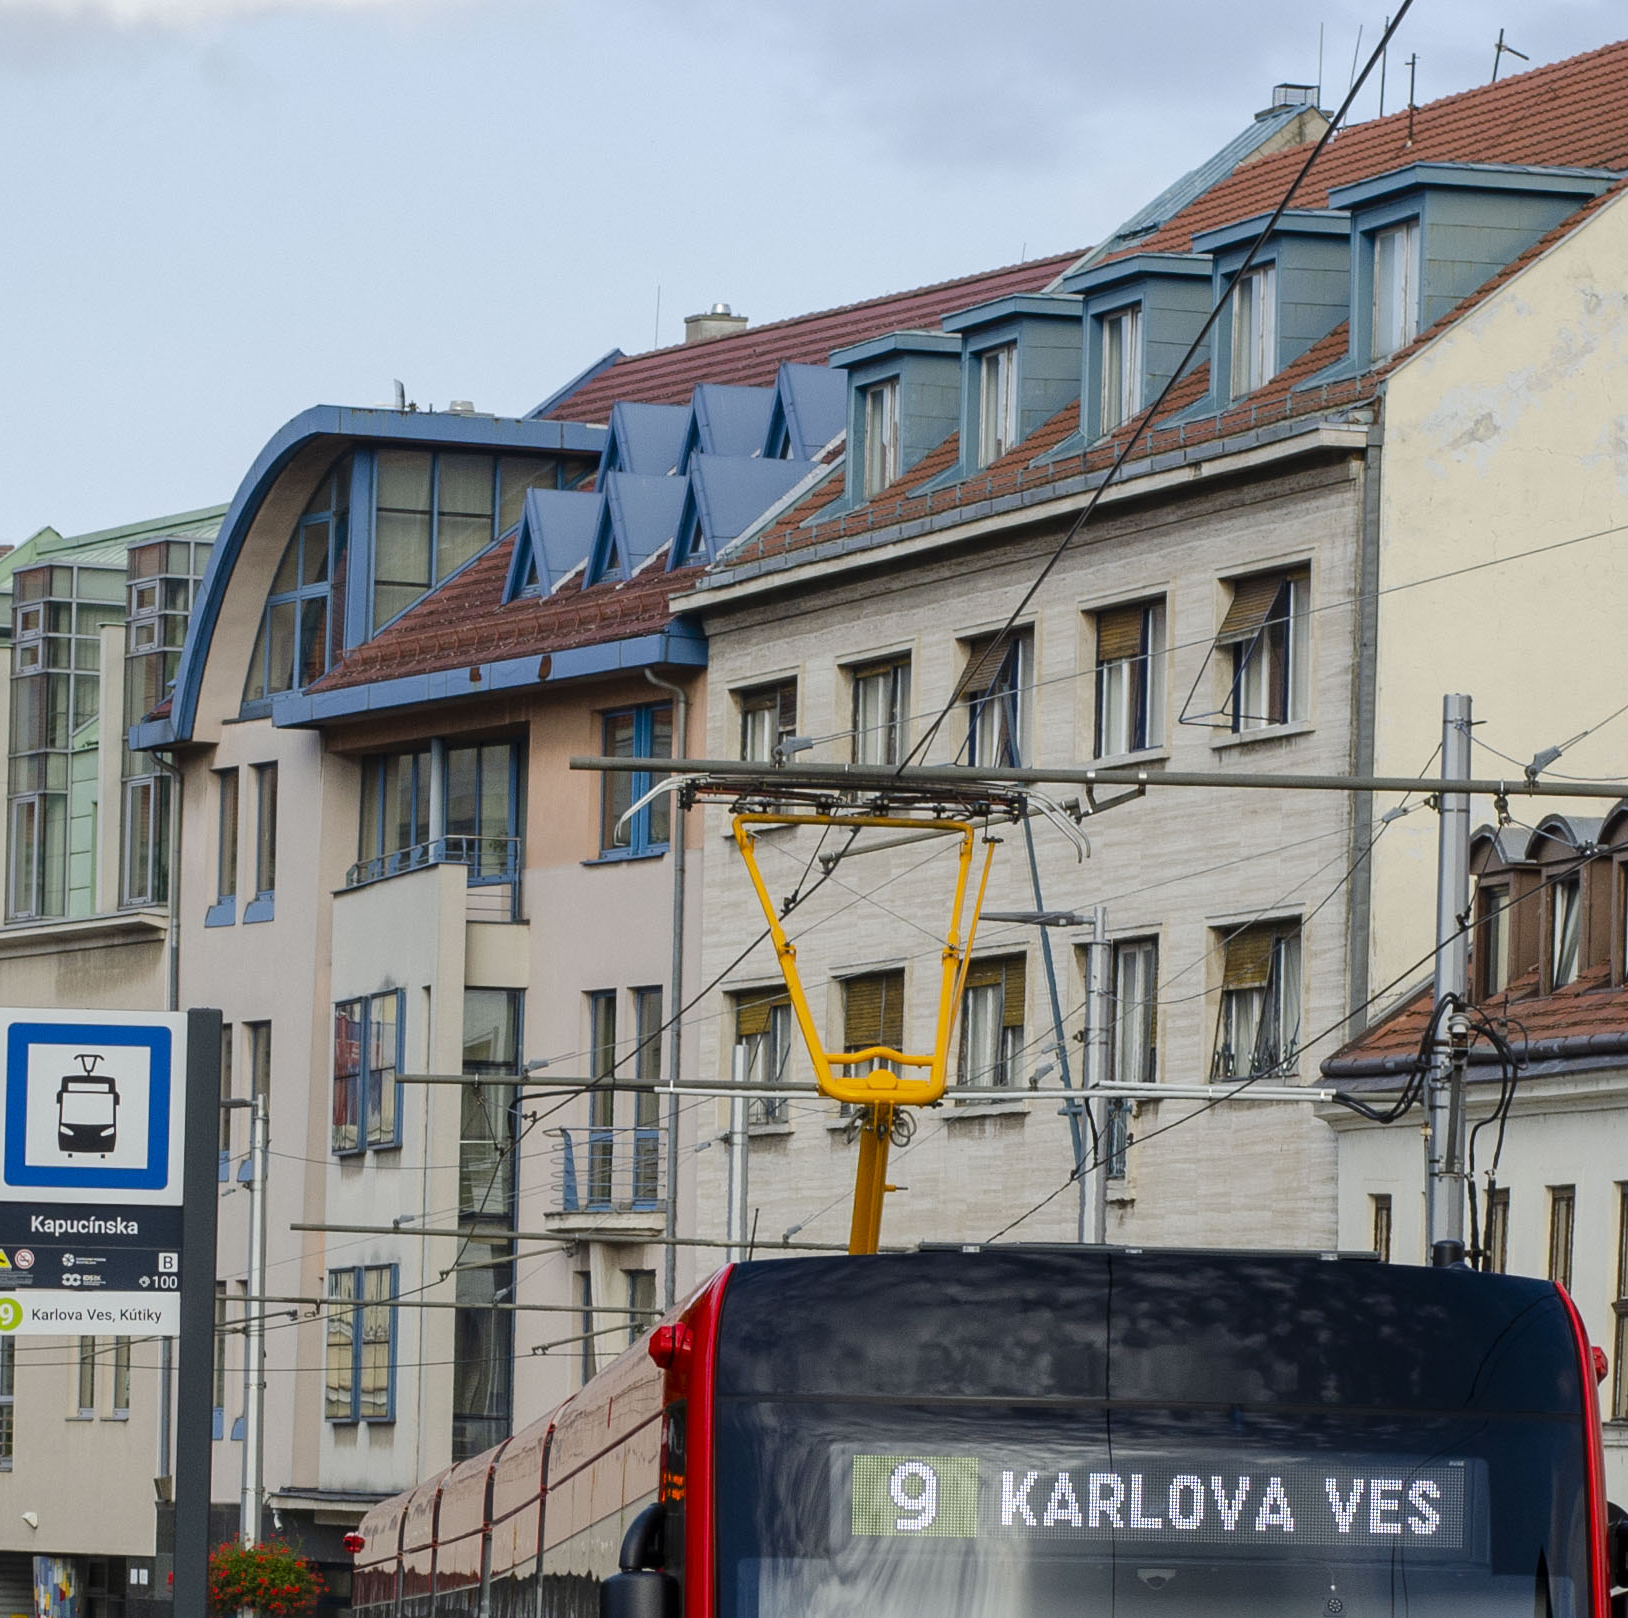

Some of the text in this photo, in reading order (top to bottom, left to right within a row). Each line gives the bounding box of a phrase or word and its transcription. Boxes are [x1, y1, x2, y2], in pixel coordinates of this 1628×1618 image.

[31, 1215, 139, 1237] Kapucínska
[162, 1255, 175, 1270] B
[152, 1275, 178, 1289] 100
[31, 1308, 82, 1321] Karlova
[87, 1309, 116, 1323] Ves,
[120, 1308, 163, 1324] Kútiky
[887, 1461, 1442, 1536] 9 KARLOVA VES
